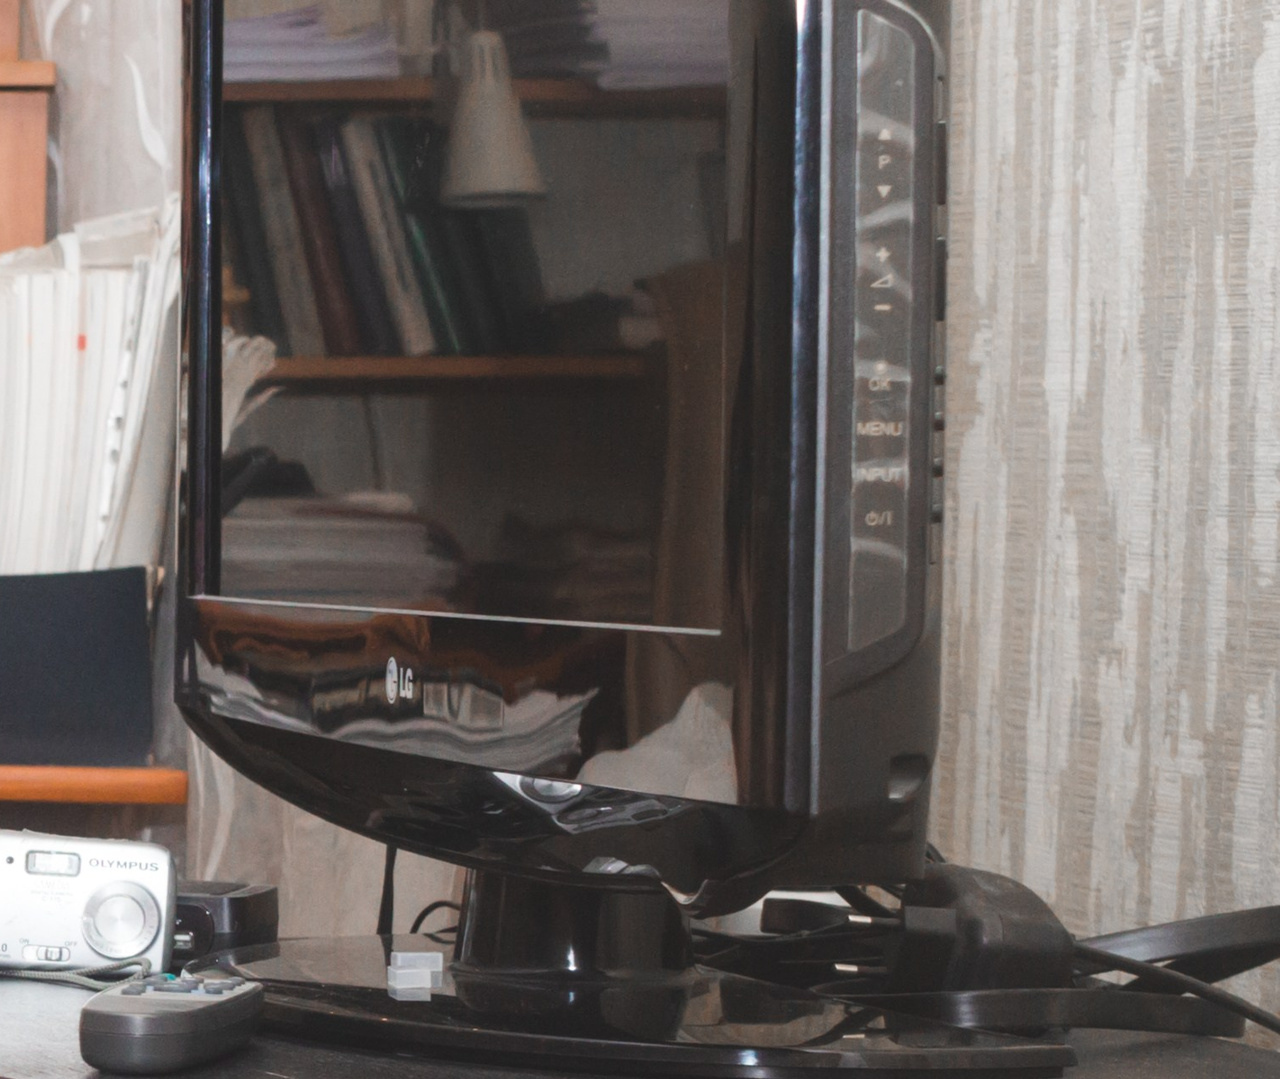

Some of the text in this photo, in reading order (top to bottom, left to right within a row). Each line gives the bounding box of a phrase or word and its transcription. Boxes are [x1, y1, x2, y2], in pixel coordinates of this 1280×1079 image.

[856, 421, 903, 437] MENU
[855, 467, 902, 482] INPUT
[399, 667, 413, 699] LG
[89, 858, 159, 872] OLYMPUS
